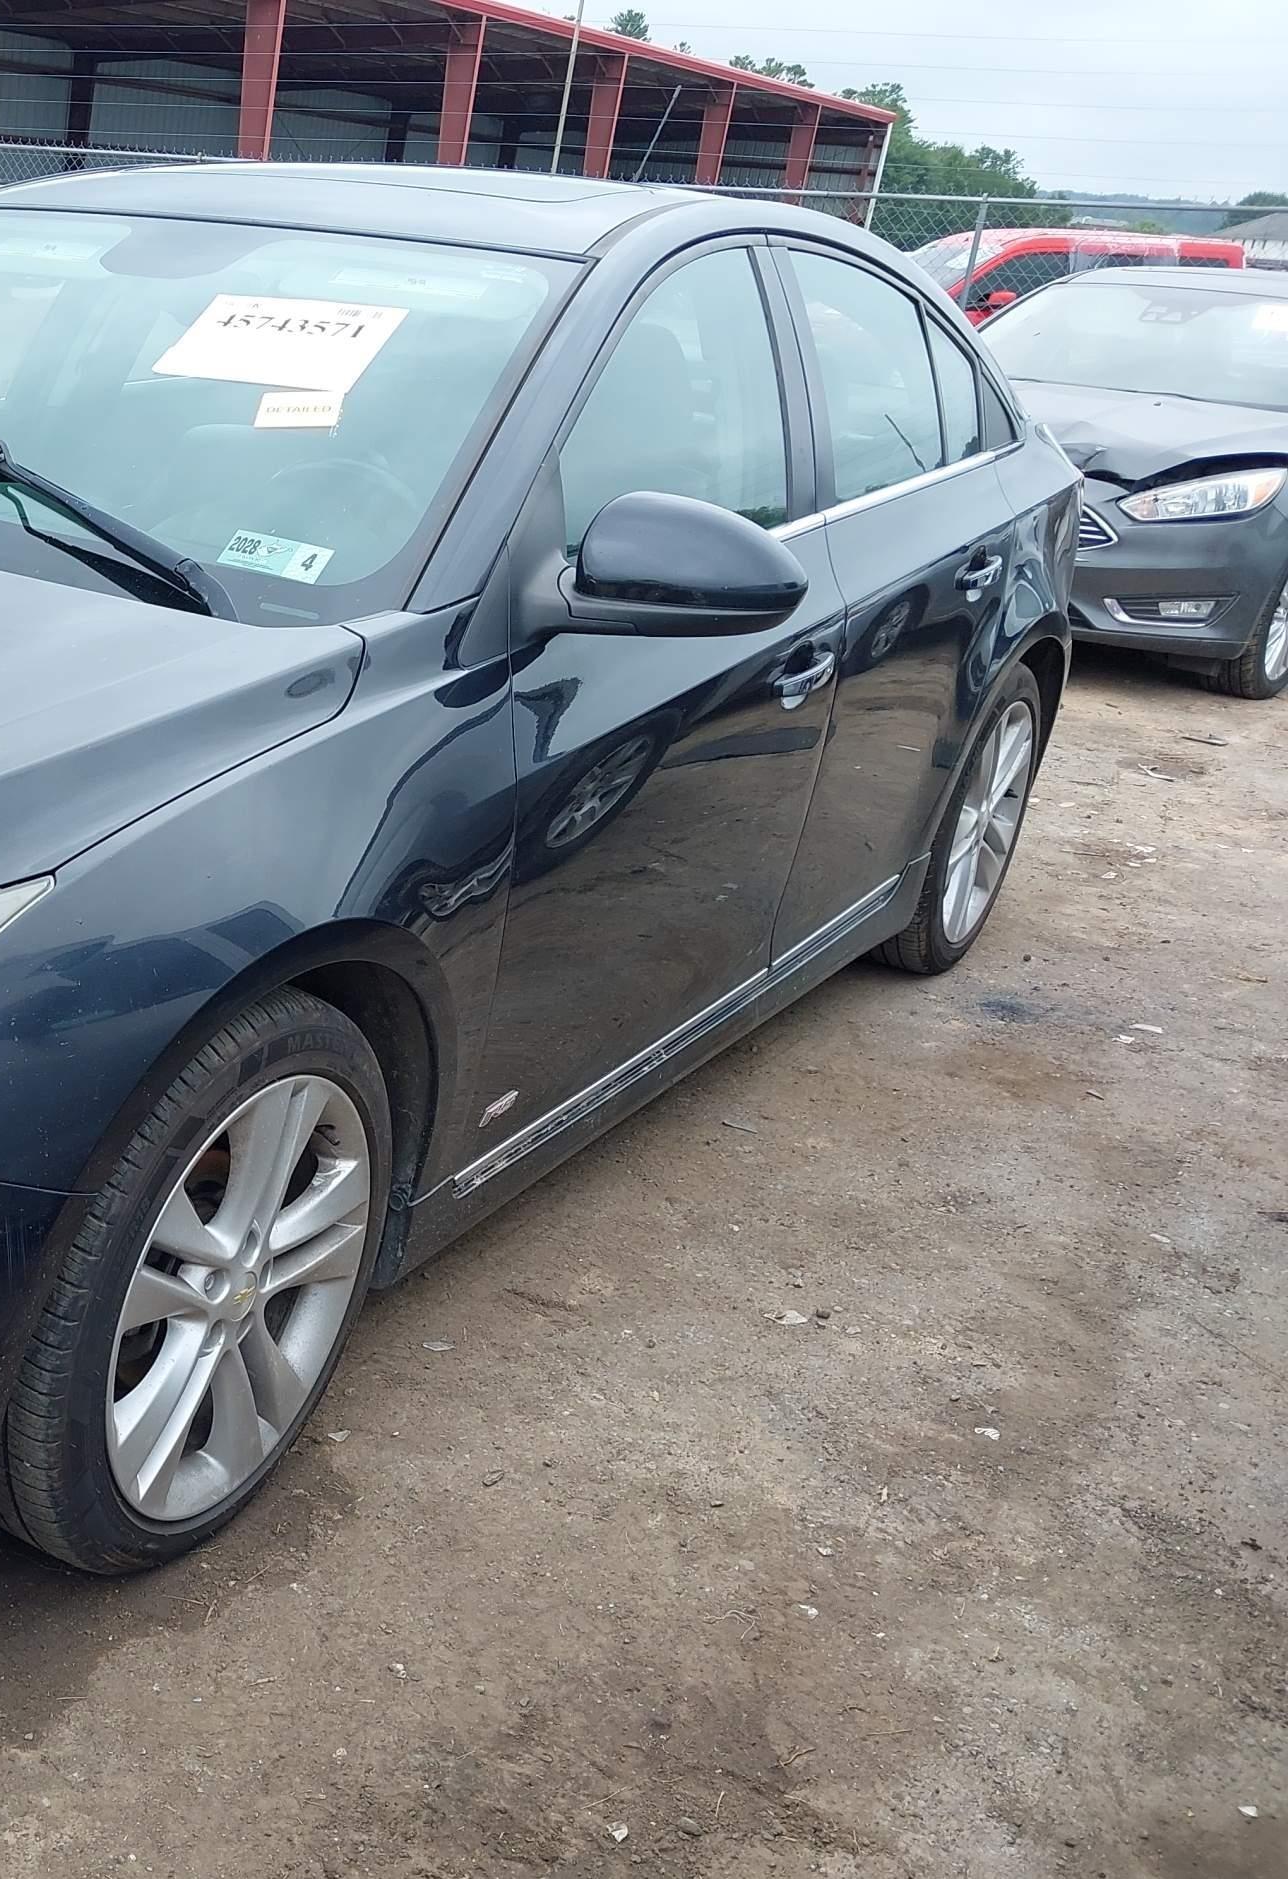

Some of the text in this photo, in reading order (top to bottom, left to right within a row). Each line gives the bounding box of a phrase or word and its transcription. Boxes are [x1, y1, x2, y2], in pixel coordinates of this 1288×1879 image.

[216, 313, 365, 338] 45743571
[265, 405, 333, 415] DETAILED
[228, 535, 318, 572] 2028 4
